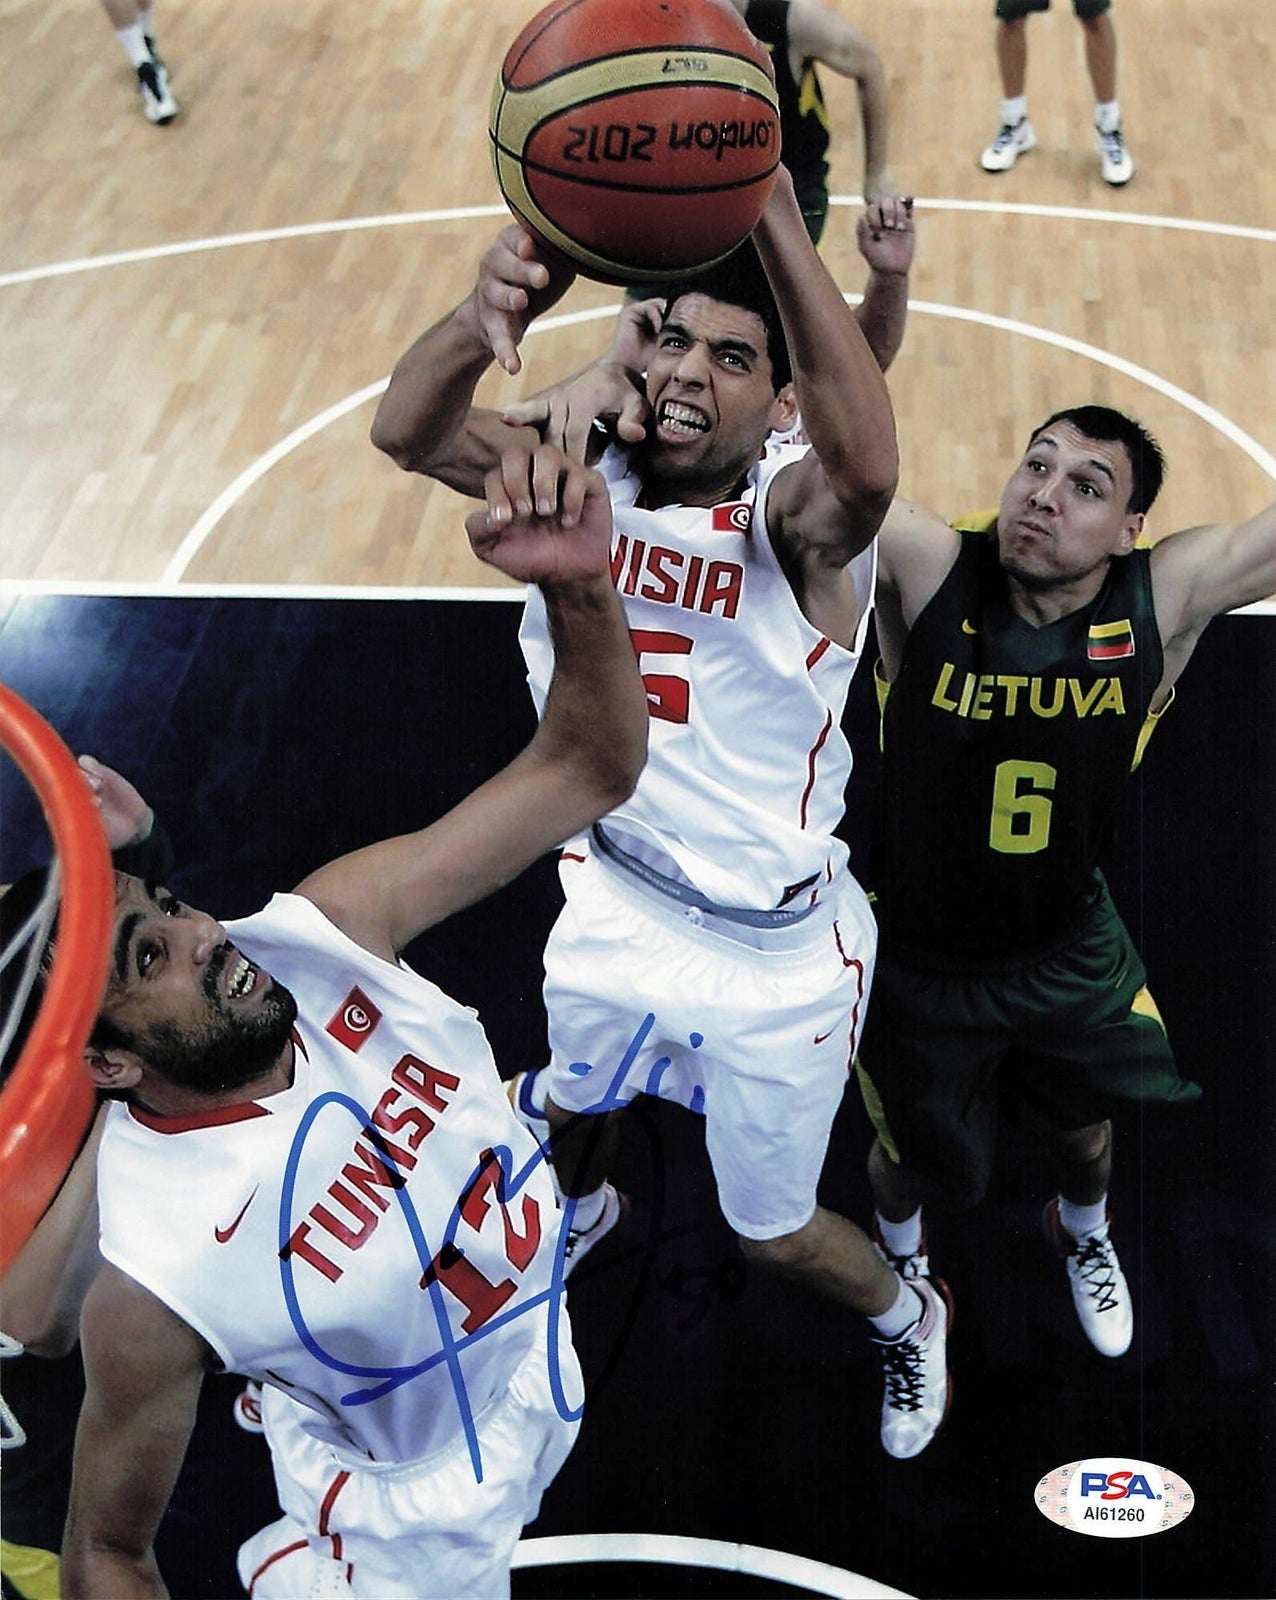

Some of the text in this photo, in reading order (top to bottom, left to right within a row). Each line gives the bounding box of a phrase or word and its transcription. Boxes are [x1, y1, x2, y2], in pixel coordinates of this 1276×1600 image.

[563, 119, 775, 163] London 2012
[608, 533, 744, 620] NISIA
[931, 662, 1126, 720] LIETUVA
[989, 759, 1057, 854] 6
[278, 1053, 460, 1283] TUNISA
[419, 1147, 542, 1336] 12
